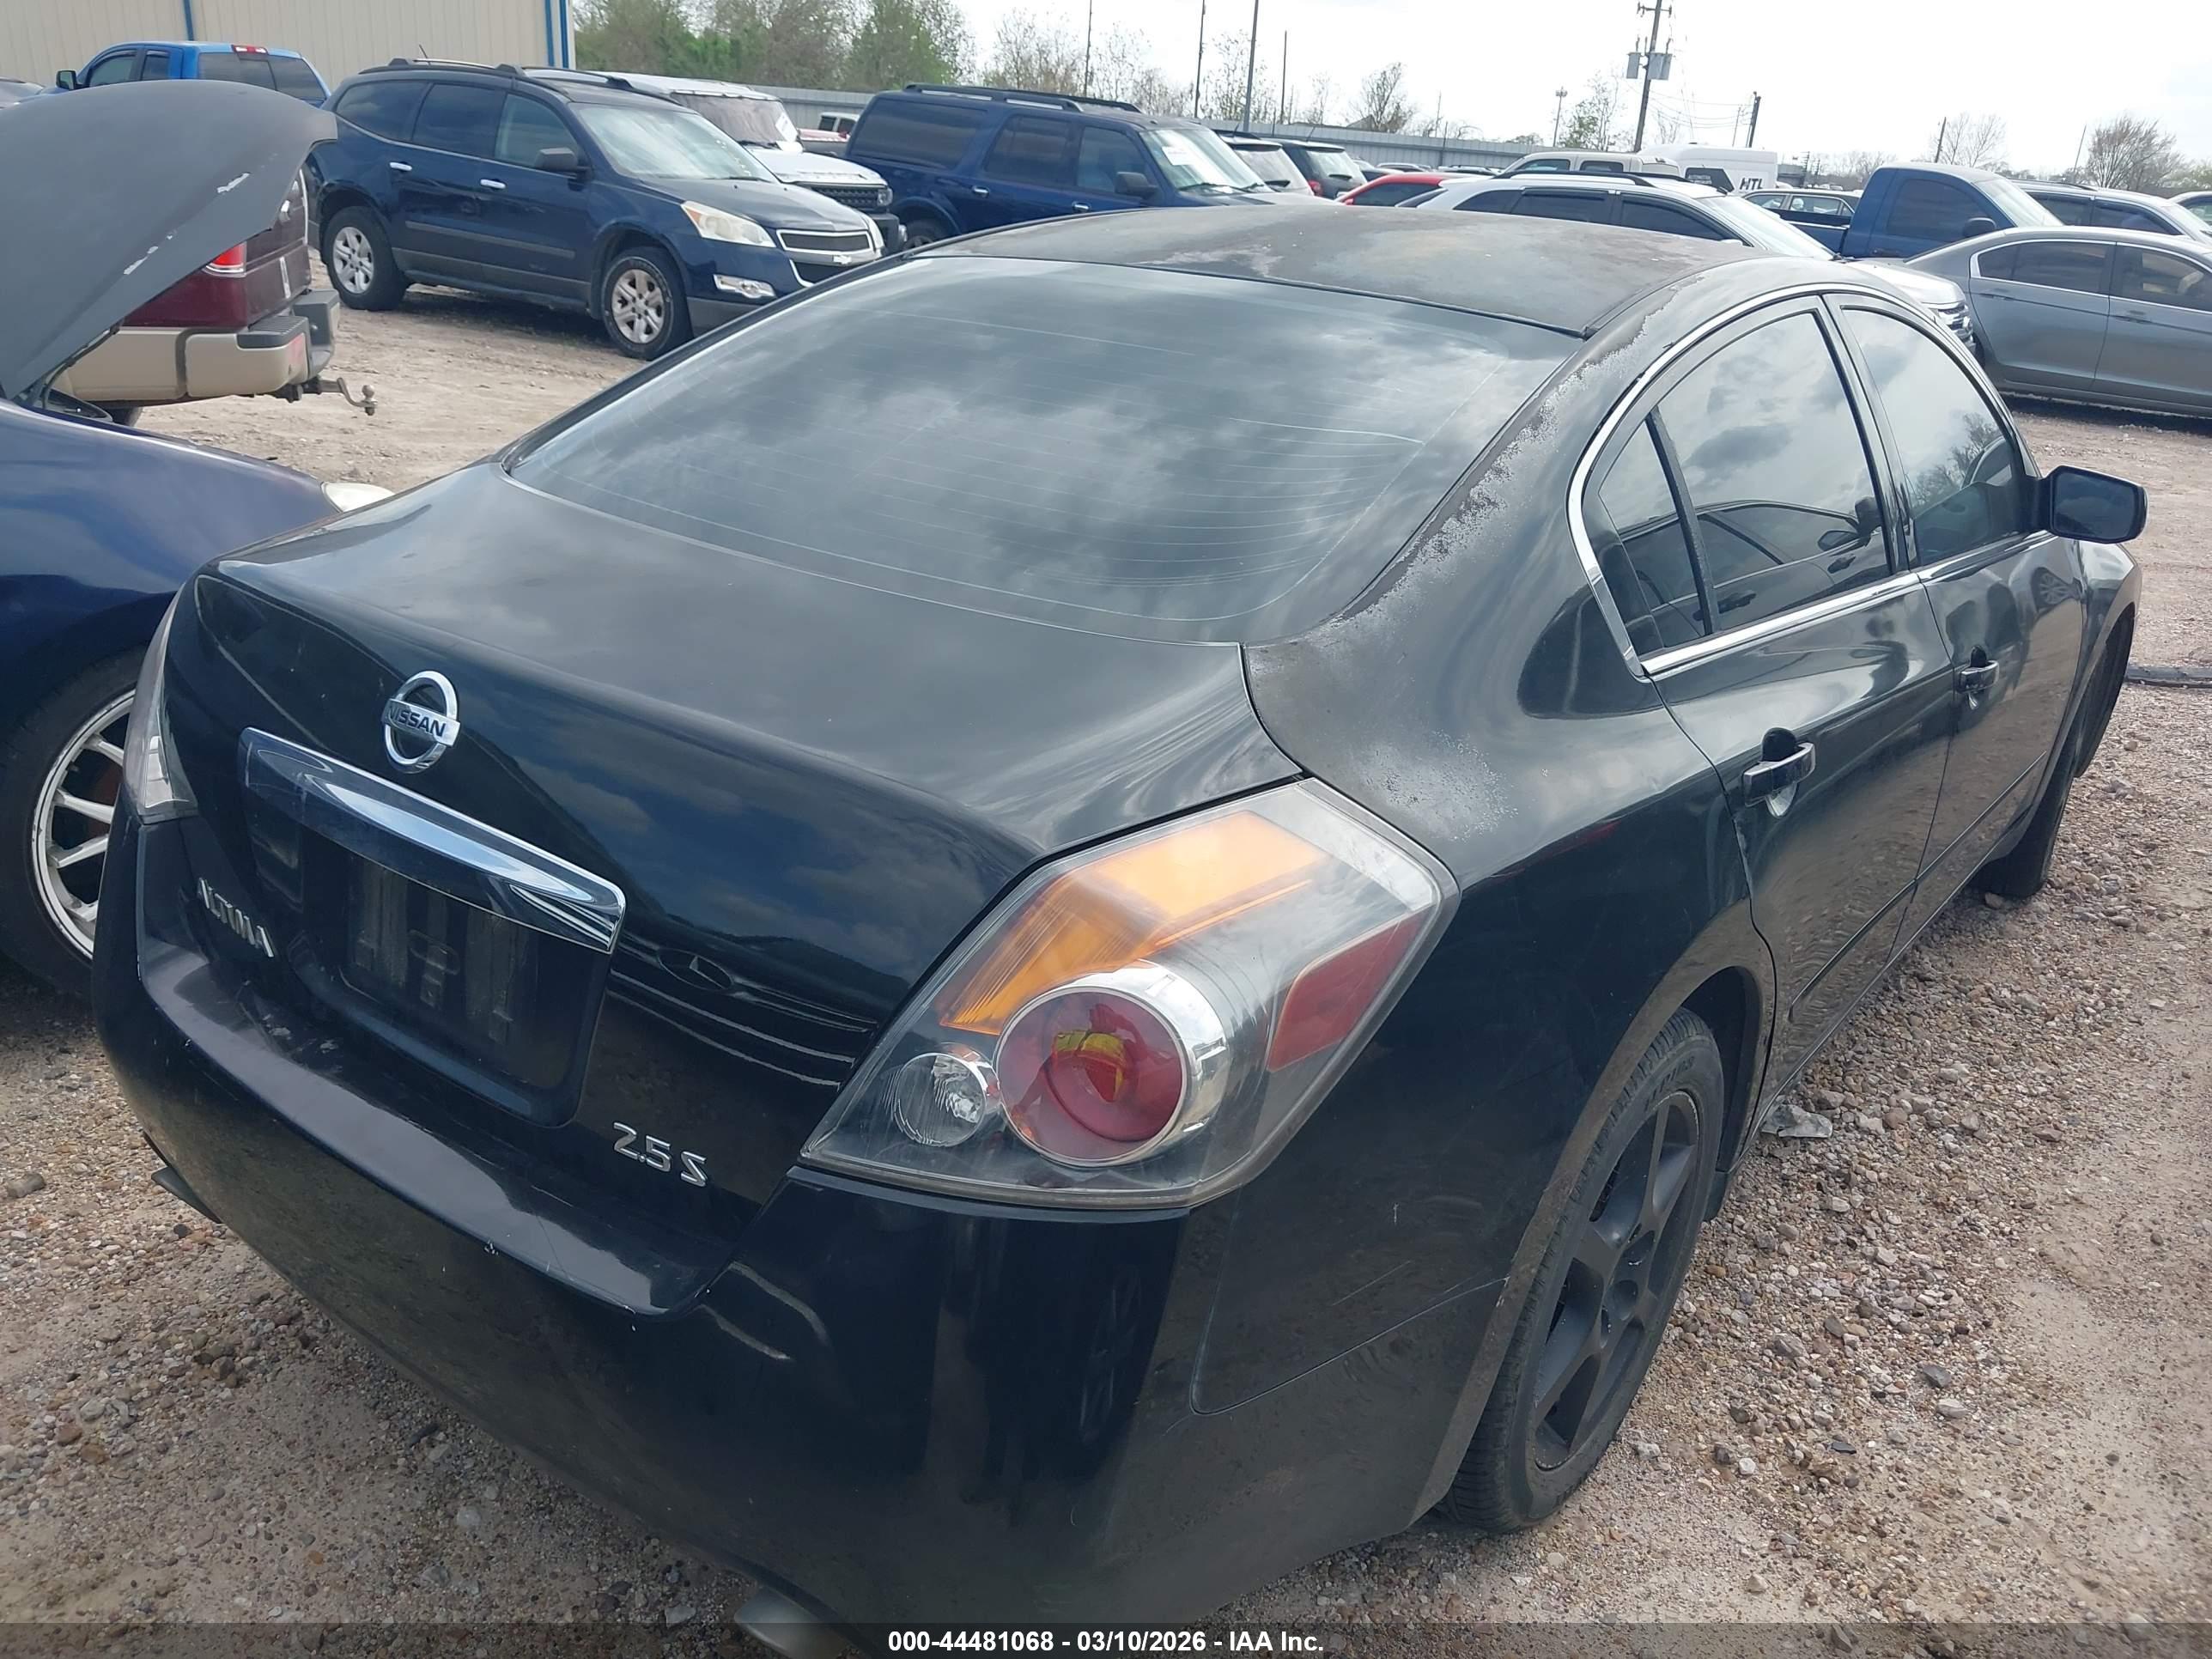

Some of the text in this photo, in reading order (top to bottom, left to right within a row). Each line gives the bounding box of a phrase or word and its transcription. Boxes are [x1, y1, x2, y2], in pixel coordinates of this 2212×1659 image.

[1739, 177, 1764, 190] HTL
[387, 702, 447, 738] NISSAN
[613, 1121, 708, 1187] 2.5 S
